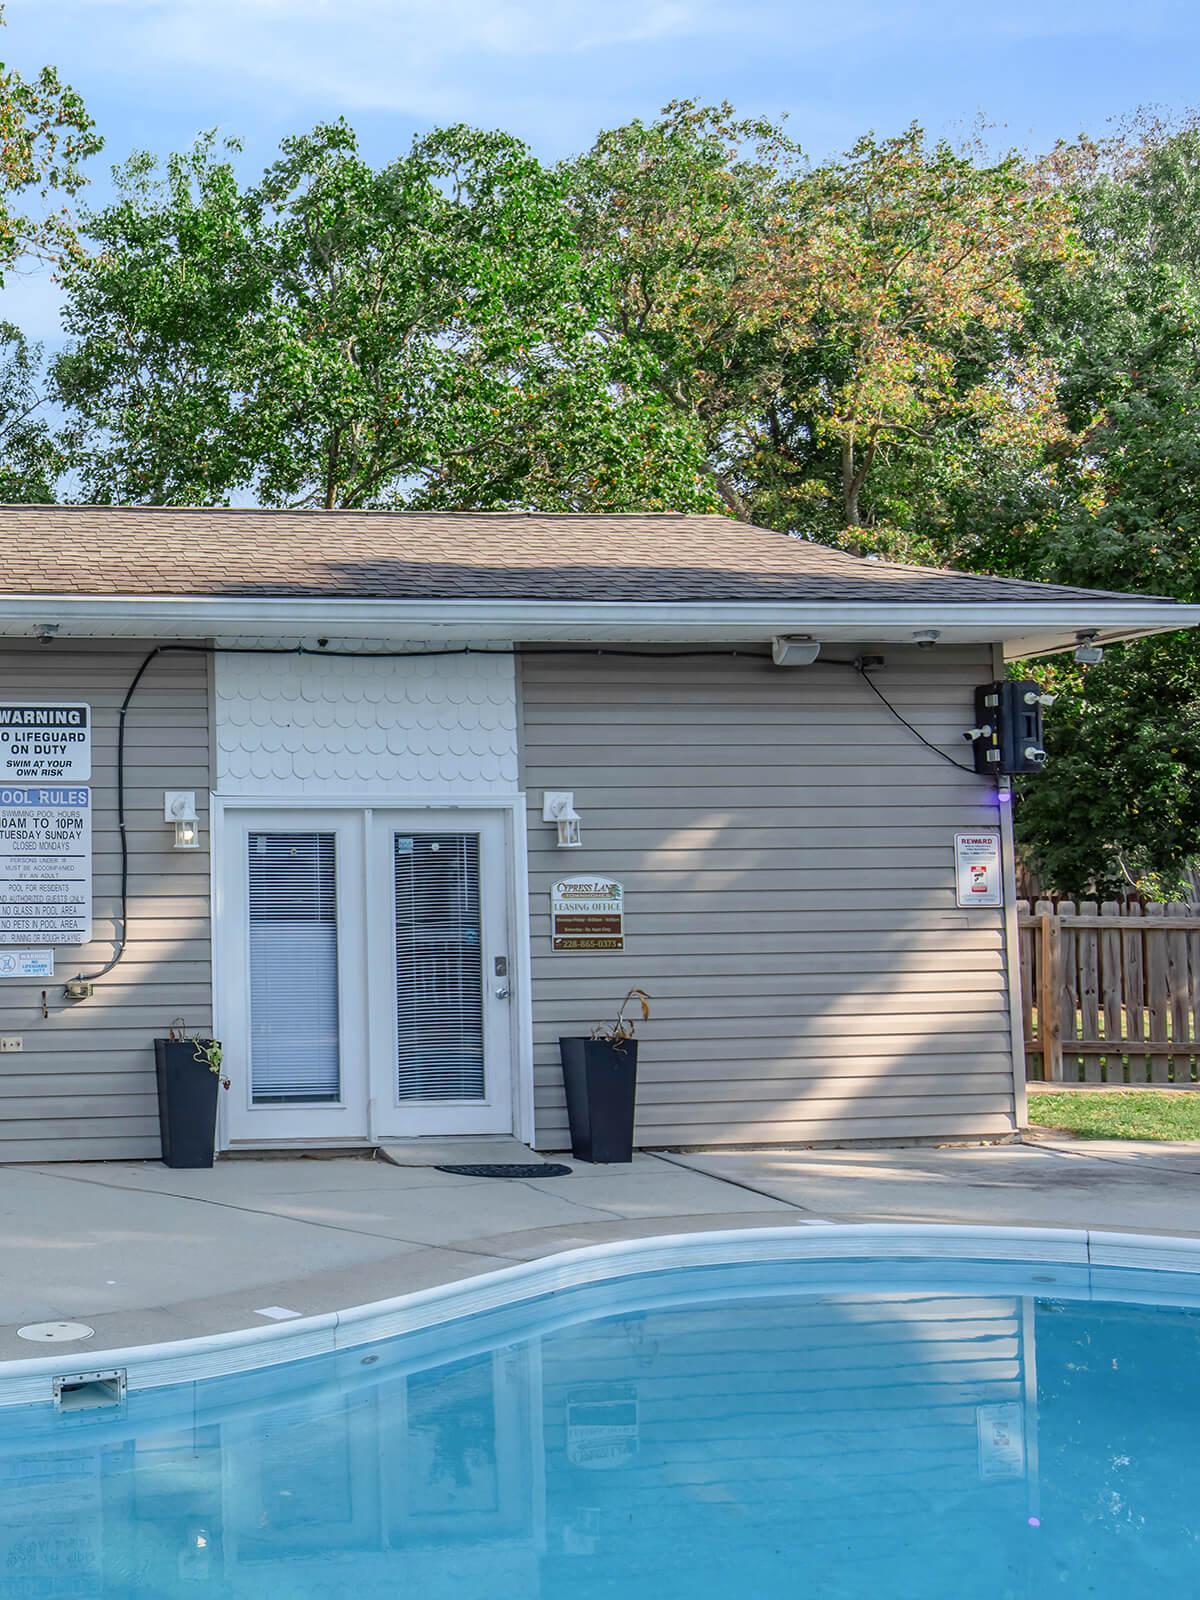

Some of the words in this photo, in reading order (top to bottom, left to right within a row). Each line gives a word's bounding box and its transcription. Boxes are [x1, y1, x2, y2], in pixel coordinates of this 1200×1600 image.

[15, 732, 86, 742] LIFEGUARD
[11, 745, 29, 754] ON
[34, 745, 67, 754] DUTY
[6, 760, 31, 768] SWIM
[33, 760, 45, 768] AT
[47, 760, 72, 768] YOUR
[16, 769, 37, 777] OWN
[41, 769, 64, 777] RISK
[40, 790, 87, 804] RULES
[2, 810, 34, 818] SWIMMING
[37, 810, 55, 818] POOL
[58, 810, 81, 818] HOURS
[33, 818, 49, 829] TO
[56, 818, 83, 829] 10PM
[0, 830, 41, 840] TUESDAY
[45, 830, 82, 840] SUNDAY
[12, 841, 37, 850] CLOSED
[39, 841, 70, 850] MONDAYS
[8, 884, 23, 892] POOL
[25, 884, 38, 892] FOR
[39, 884, 69, 892] RESIDENTS
[557, 883, 593, 893] CYPRESS
[2, 906, 11, 915] NO
[13, 906, 33, 915] GLASS
[35, 906, 40, 915] IN
[42, 906, 58, 915] POOL
[61, 906, 77, 915] AREA
[555, 903, 590, 912] LEASING
[592, 903, 621, 912] OFFICE
[1, 920, 11, 929] NO
[13, 920, 30, 929] PETS
[32, 920, 38, 929] IN
[40, 920, 57, 929] POOL
[60, 920, 78, 929] AREA
[33, 934, 41, 942] OR
[42, 934, 59, 942] ROUGH
